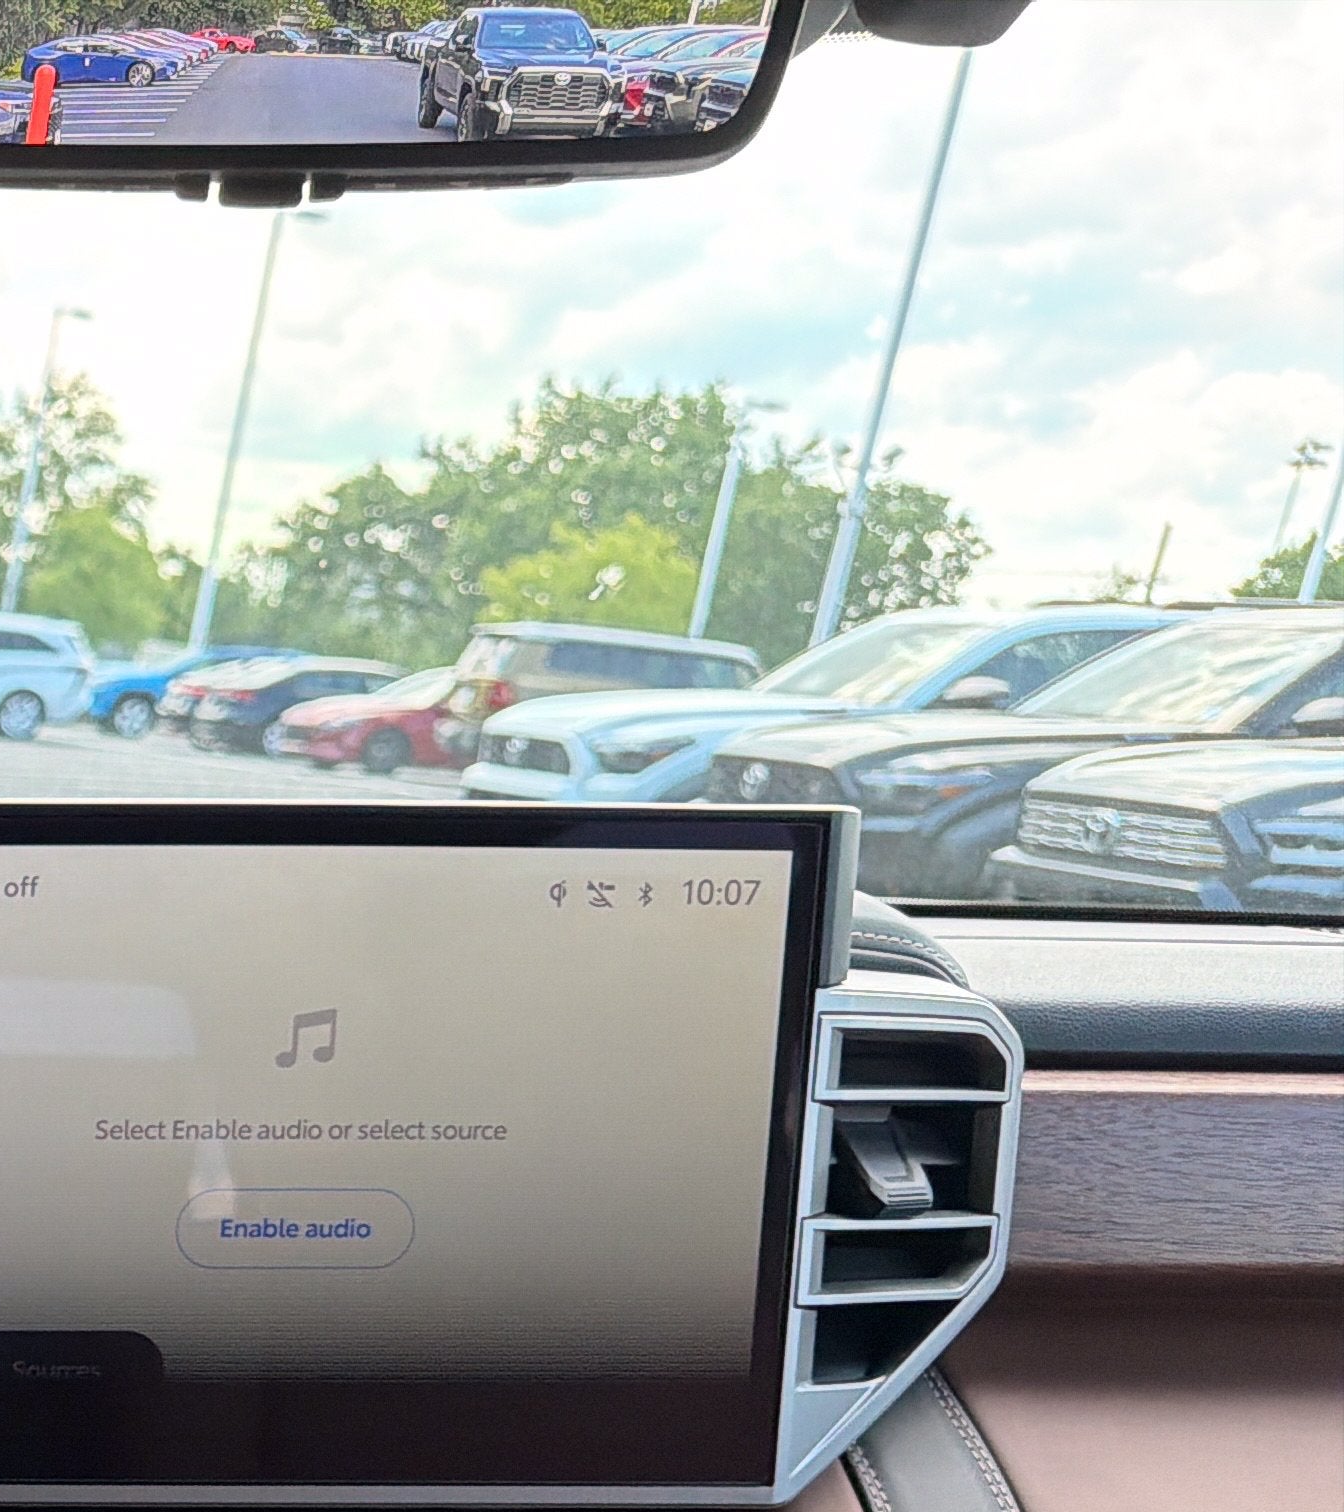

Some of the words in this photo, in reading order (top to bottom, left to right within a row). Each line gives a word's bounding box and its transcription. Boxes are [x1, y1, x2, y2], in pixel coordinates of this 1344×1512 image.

[4, 875, 40, 898] off
[682, 879, 761, 906] 10:07
[94, 1119, 166, 1141] Select
[172, 1119, 252, 1140] Enable
[256, 1119, 323, 1140] audio
[328, 1125, 352, 1140] or
[357, 1119, 425, 1141] select
[430, 1123, 508, 1141] source
[219, 1218, 300, 1239] Enable
[304, 1218, 372, 1239] audio
